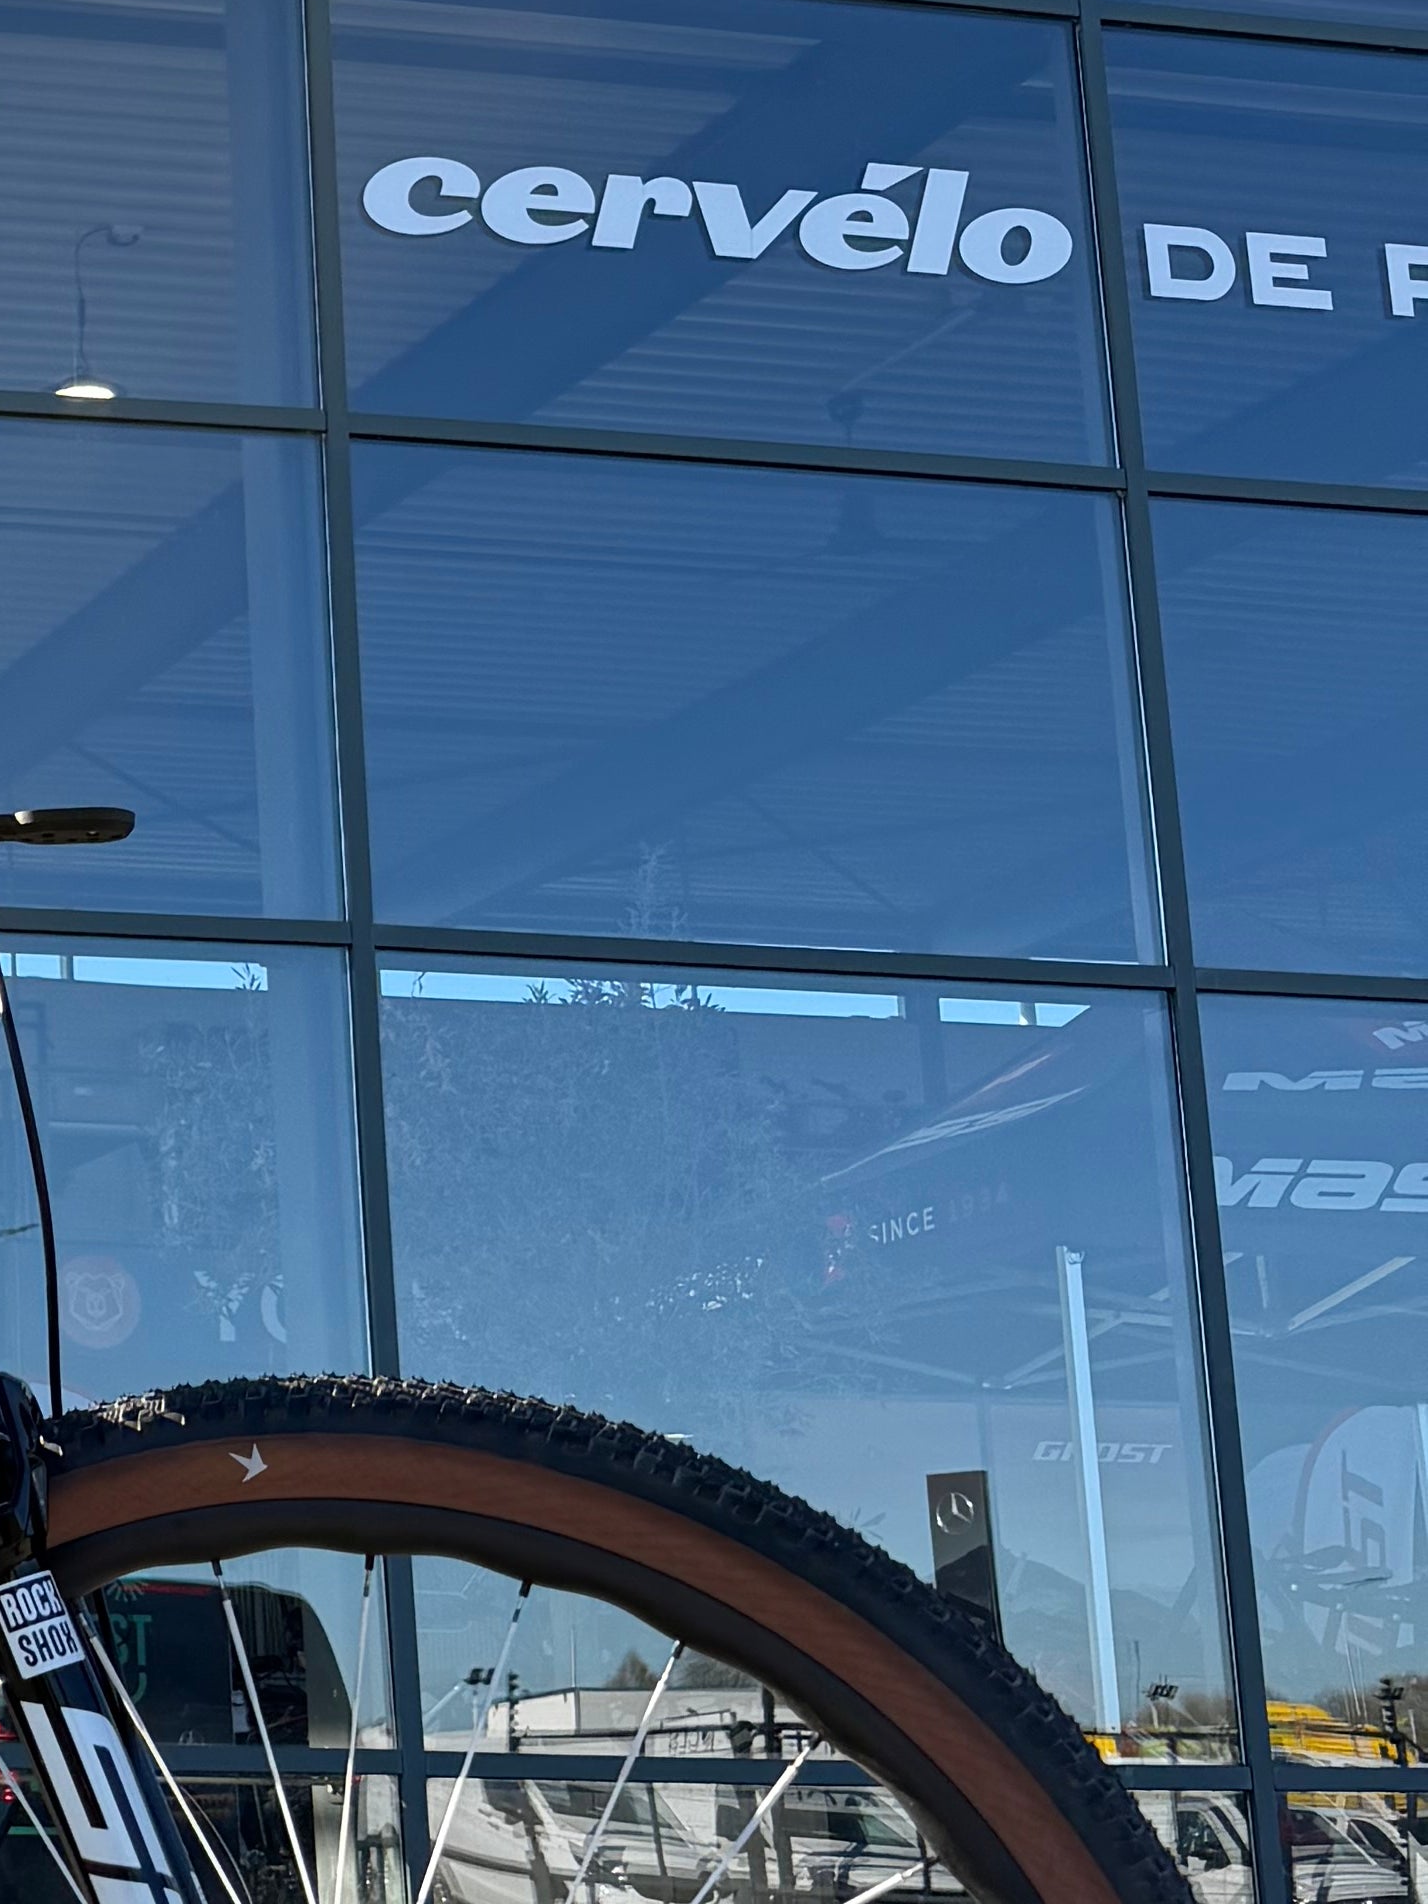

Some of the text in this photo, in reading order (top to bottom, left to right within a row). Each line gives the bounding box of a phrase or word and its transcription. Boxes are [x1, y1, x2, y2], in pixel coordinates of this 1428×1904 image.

[362, 156, 1074, 284] cervélo
[1144, 223, 1334, 311] DE
[868, 1206, 936, 1245] SINCE
[0, 1579, 64, 1629] ROCK
[17, 1621, 79, 1667] SHOX
